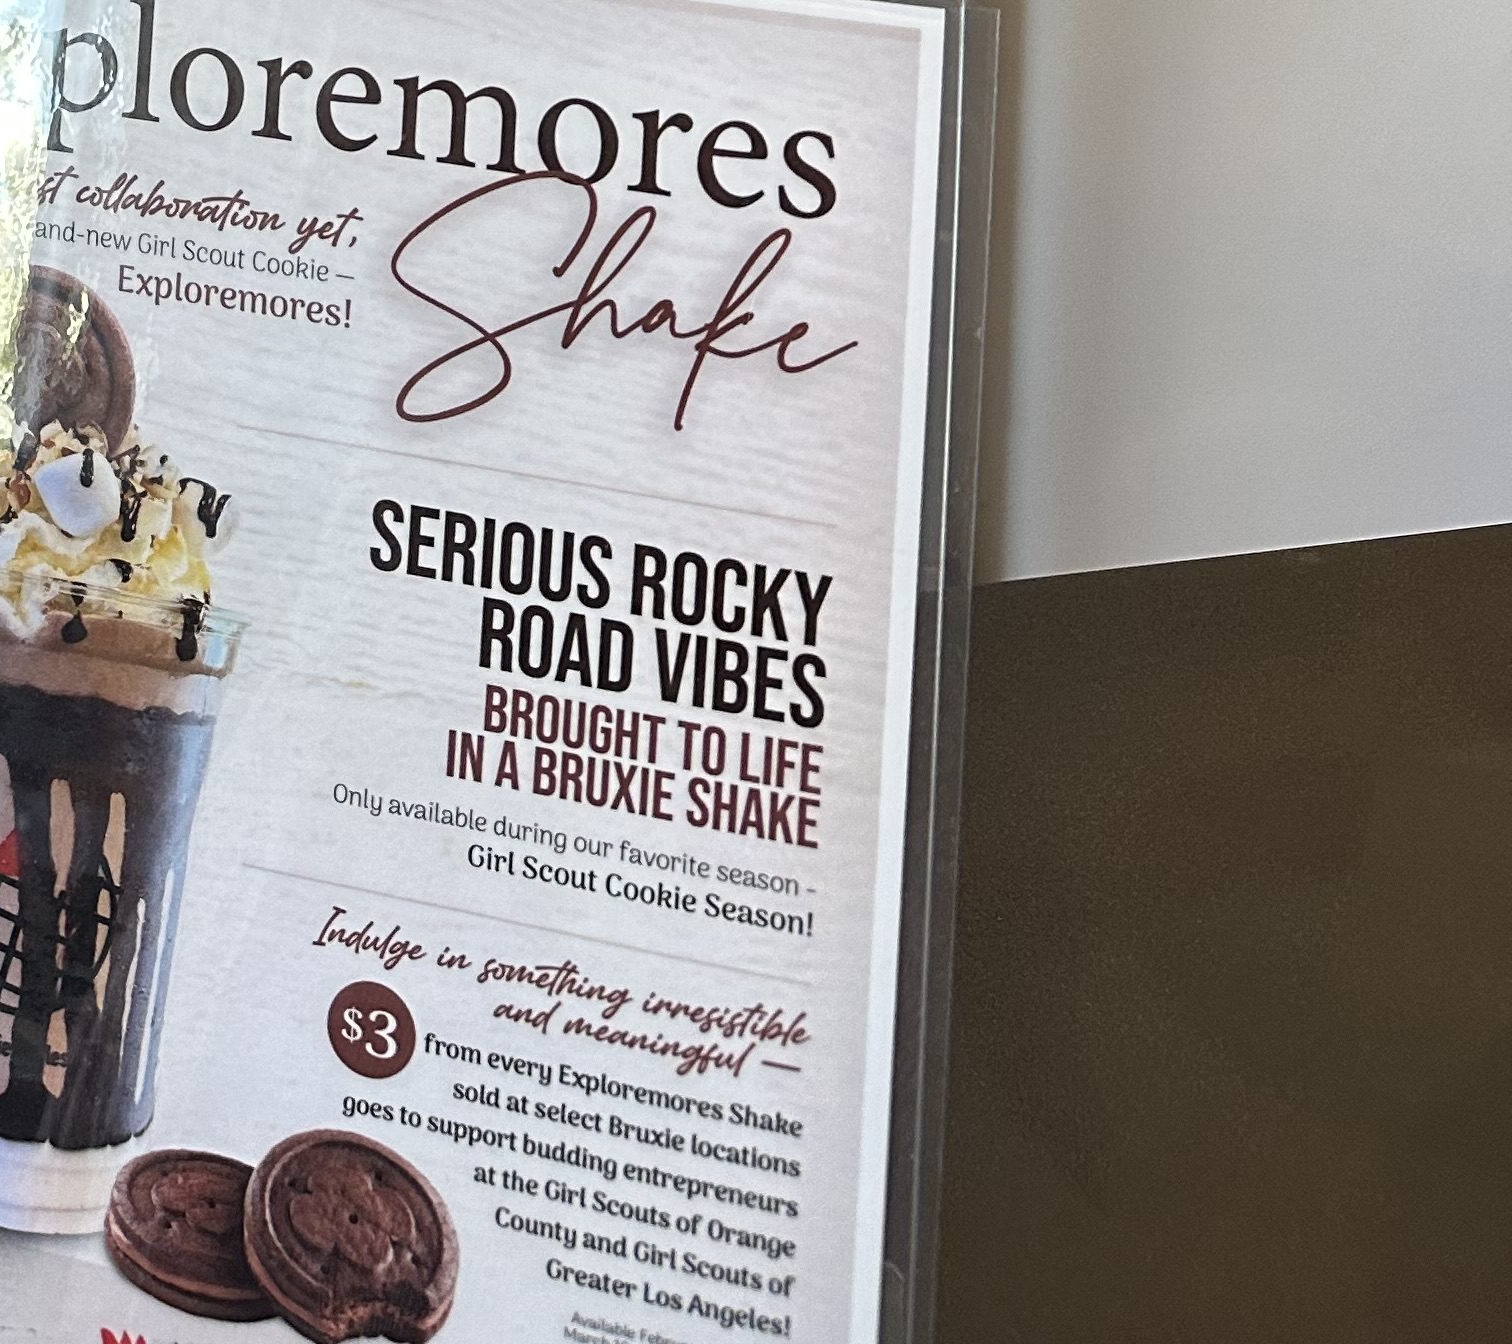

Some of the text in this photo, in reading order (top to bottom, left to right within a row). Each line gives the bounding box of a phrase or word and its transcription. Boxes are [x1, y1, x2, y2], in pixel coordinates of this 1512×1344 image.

[34, 220, 133, 252] and-new
[138, 231, 177, 260] Girl
[182, 239, 246, 270] Scout
[252, 249, 330, 283] Cookie
[75, 171, 287, 232] collaboration
[288, 206, 364, 255] yet,
[118, 264, 353, 329] Exploremores!
[390, 168, 859, 432] Shake
[369, 498, 834, 647] SERIOUS ROCKY
[478, 596, 828, 729] ROAD VIBES
[483, 683, 825, 796] BROUGHT TO LIFE
[445, 729, 822, 850] IN A BRUXIE SHAKE
[332, 782, 383, 818] Only
[388, 795, 488, 833] available
[492, 815, 568, 855] during
[573, 835, 614, 858] our
[619, 840, 711, 879] favorite
[716, 864, 800, 897] season
[466, 843, 814, 938] Girl Scout Cookie Season!
[312, 906, 813, 1048] Indulge in something irresistible
[340, 1005, 399, 1061] $3
[492, 1000, 562, 1036] and
[562, 1017, 756, 1079] meaningful
[424, 1032, 804, 1138] from every Exploremores Shake
[452, 1082, 802, 1178] sold at select Bruxie locations
[342, 1095, 800, 1218] goes to support budding entrepreneurs
[473, 1165, 797, 1260] at the Girl Scouts of Orange
[494, 1206, 797, 1298] County and Girl Scouts of
[546, 1257, 793, 1339] Greater Los Angeles!
[571, 1310, 636, 1340] Available
